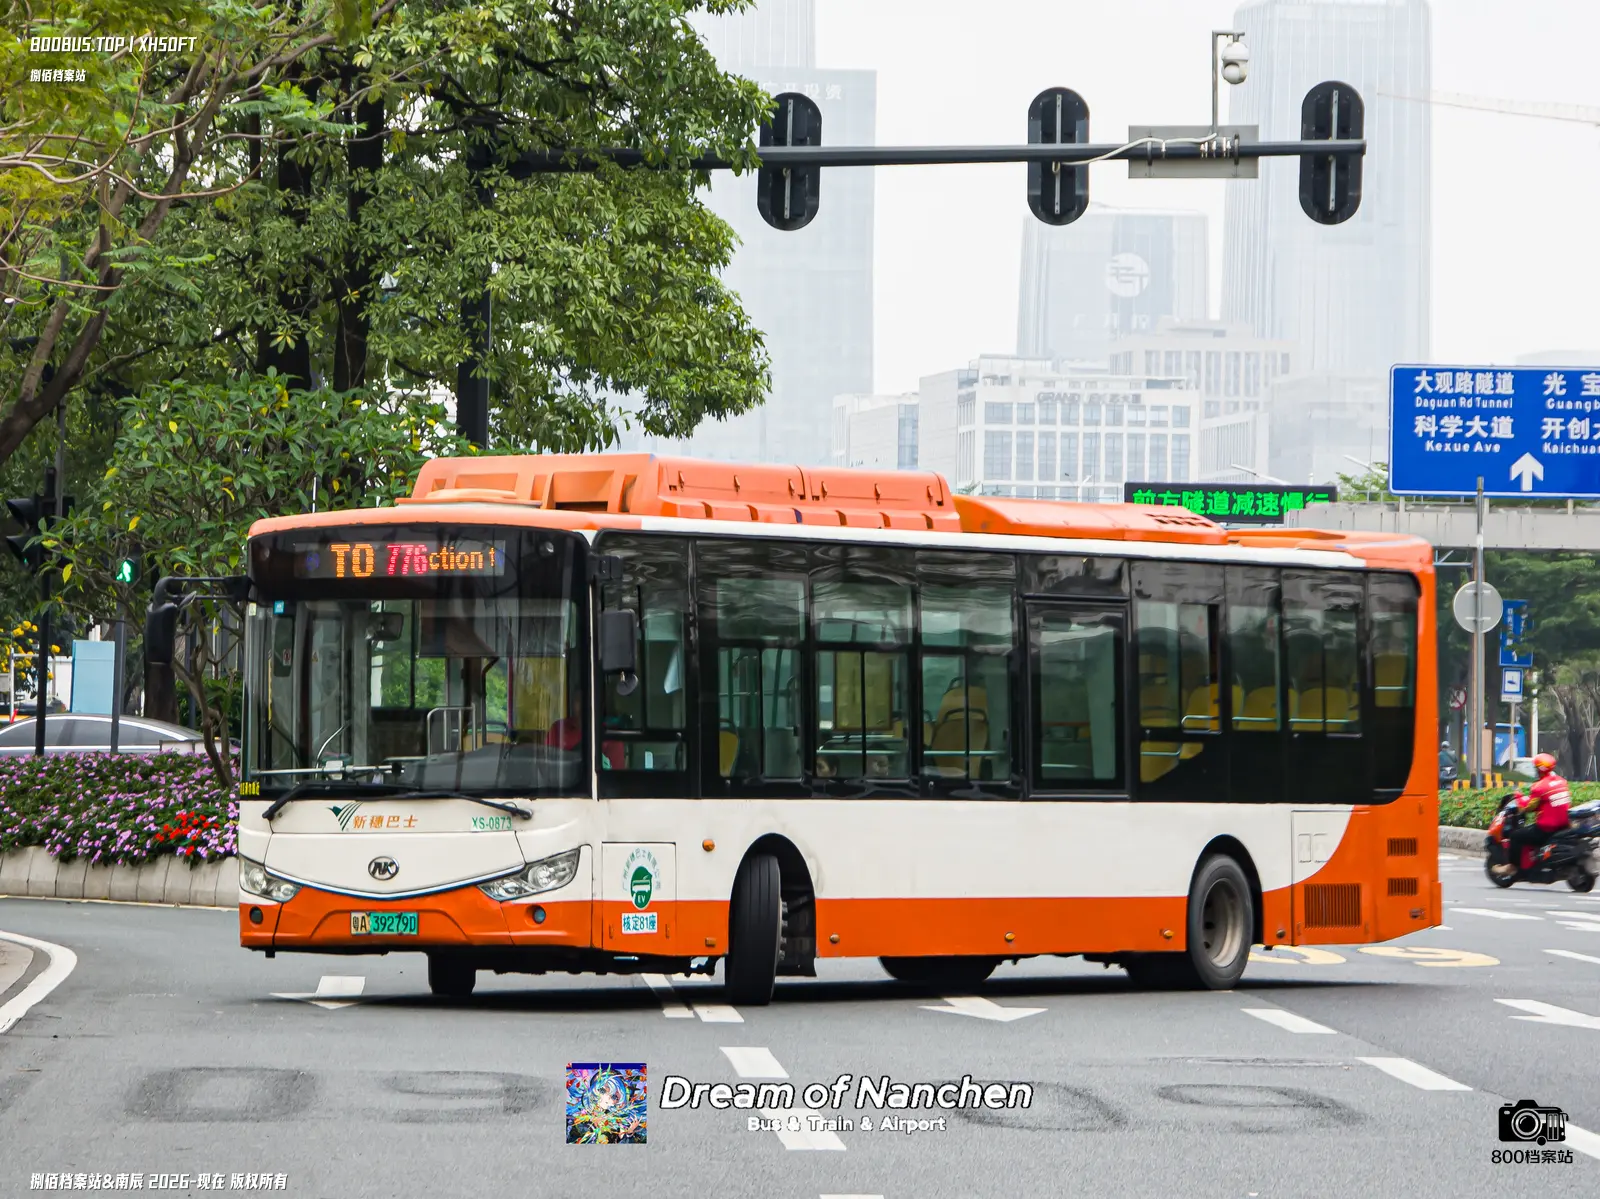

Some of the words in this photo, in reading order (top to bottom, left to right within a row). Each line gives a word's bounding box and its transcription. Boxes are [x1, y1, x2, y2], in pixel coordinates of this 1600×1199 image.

[1414, 370, 1514, 395] 大观路隧道
[1415, 396, 1457, 411] Daguan
[1460, 396, 1473, 408] Rd
[1475, 397, 1513, 408] Tunnel
[1414, 414, 1515, 439] 科学大道
[1425, 440, 1470, 453] Kexue
[1474, 441, 1501, 453] Ave
[353, 815, 419, 829] 新穗巴士
[471, 816, 513, 830] XS-0873
[623, 914, 657, 931] 核定81座
